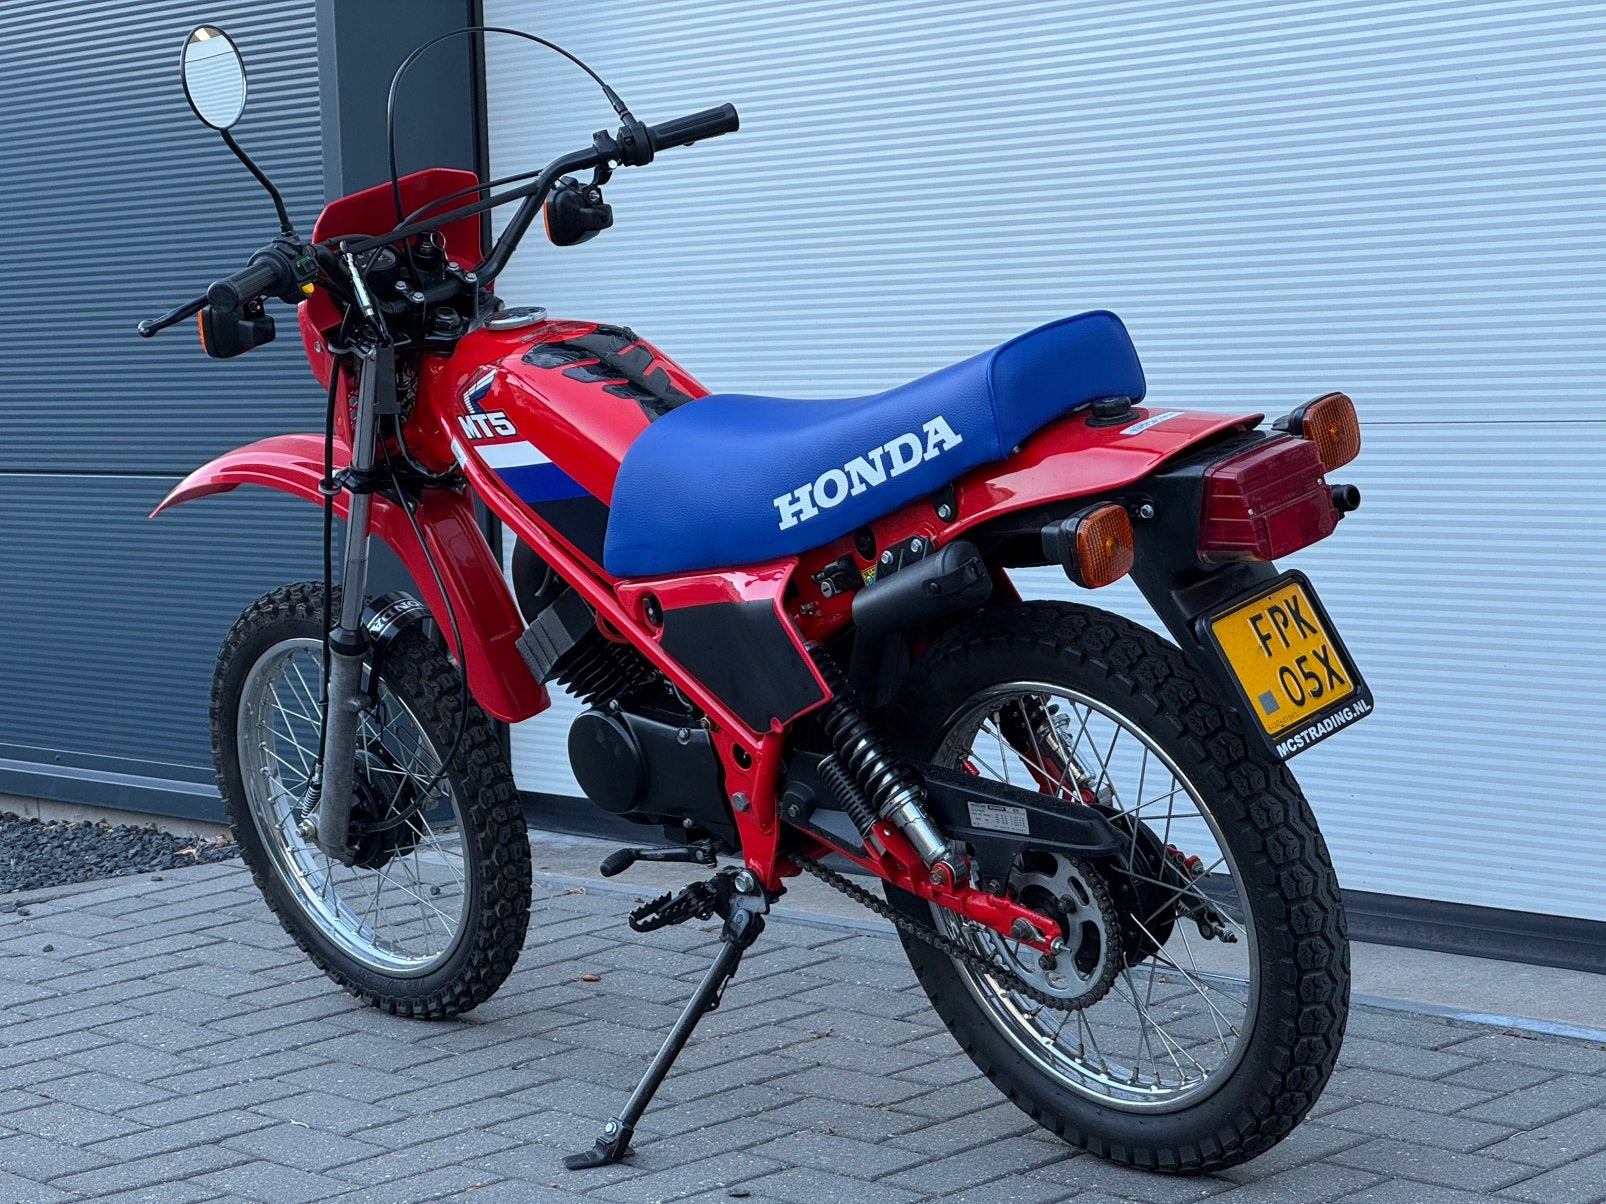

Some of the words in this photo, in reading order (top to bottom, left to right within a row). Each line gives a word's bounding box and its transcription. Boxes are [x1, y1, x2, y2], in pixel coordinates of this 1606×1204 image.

[457, 411, 516, 439] MT5
[773, 415, 963, 531] HONDA
[368, 600, 425, 632] ONDA
[1249, 594, 1318, 658] FPK
[1279, 644, 1345, 707] 05X
[1276, 700, 1372, 758] MCSTRADING.NL
